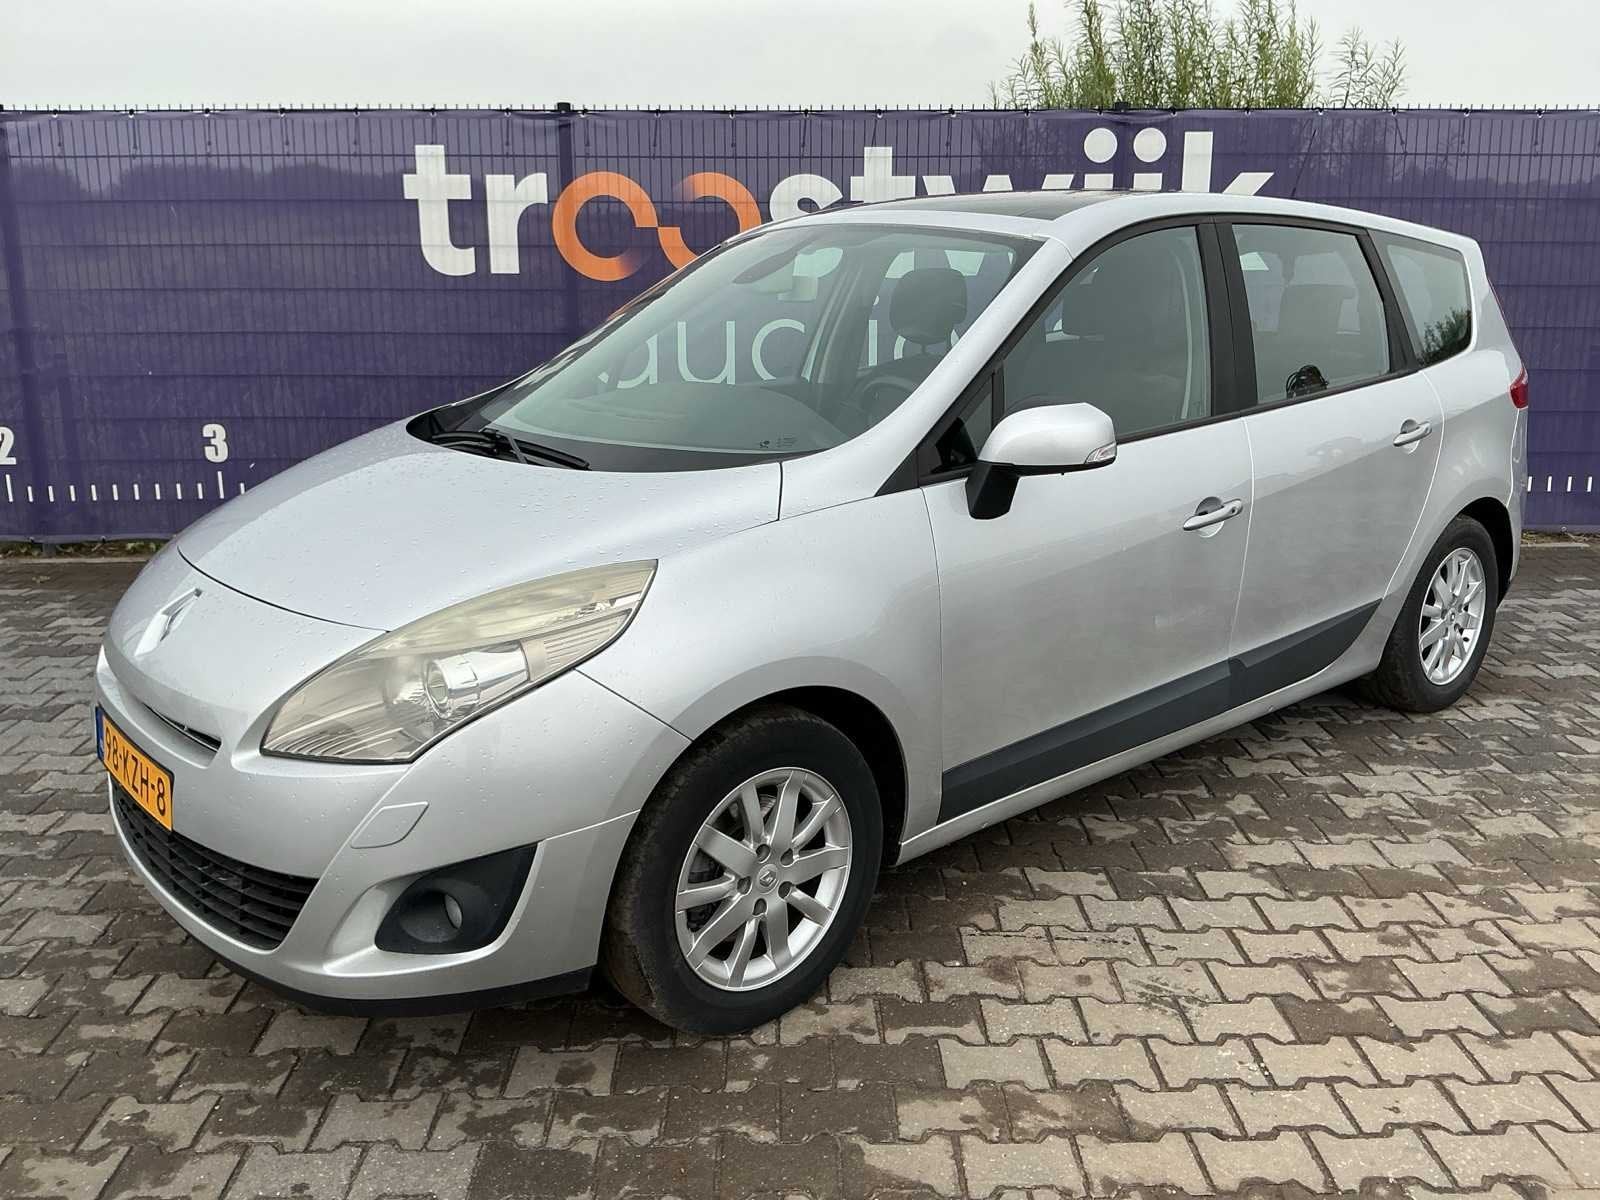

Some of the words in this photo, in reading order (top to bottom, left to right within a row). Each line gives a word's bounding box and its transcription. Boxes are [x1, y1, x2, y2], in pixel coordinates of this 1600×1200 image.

[403, 127, 1274, 281] troost
[0, 426, 17, 465] 2
[202, 423, 229, 463] 3
[105, 726, 166, 817] 98-KZH-8
